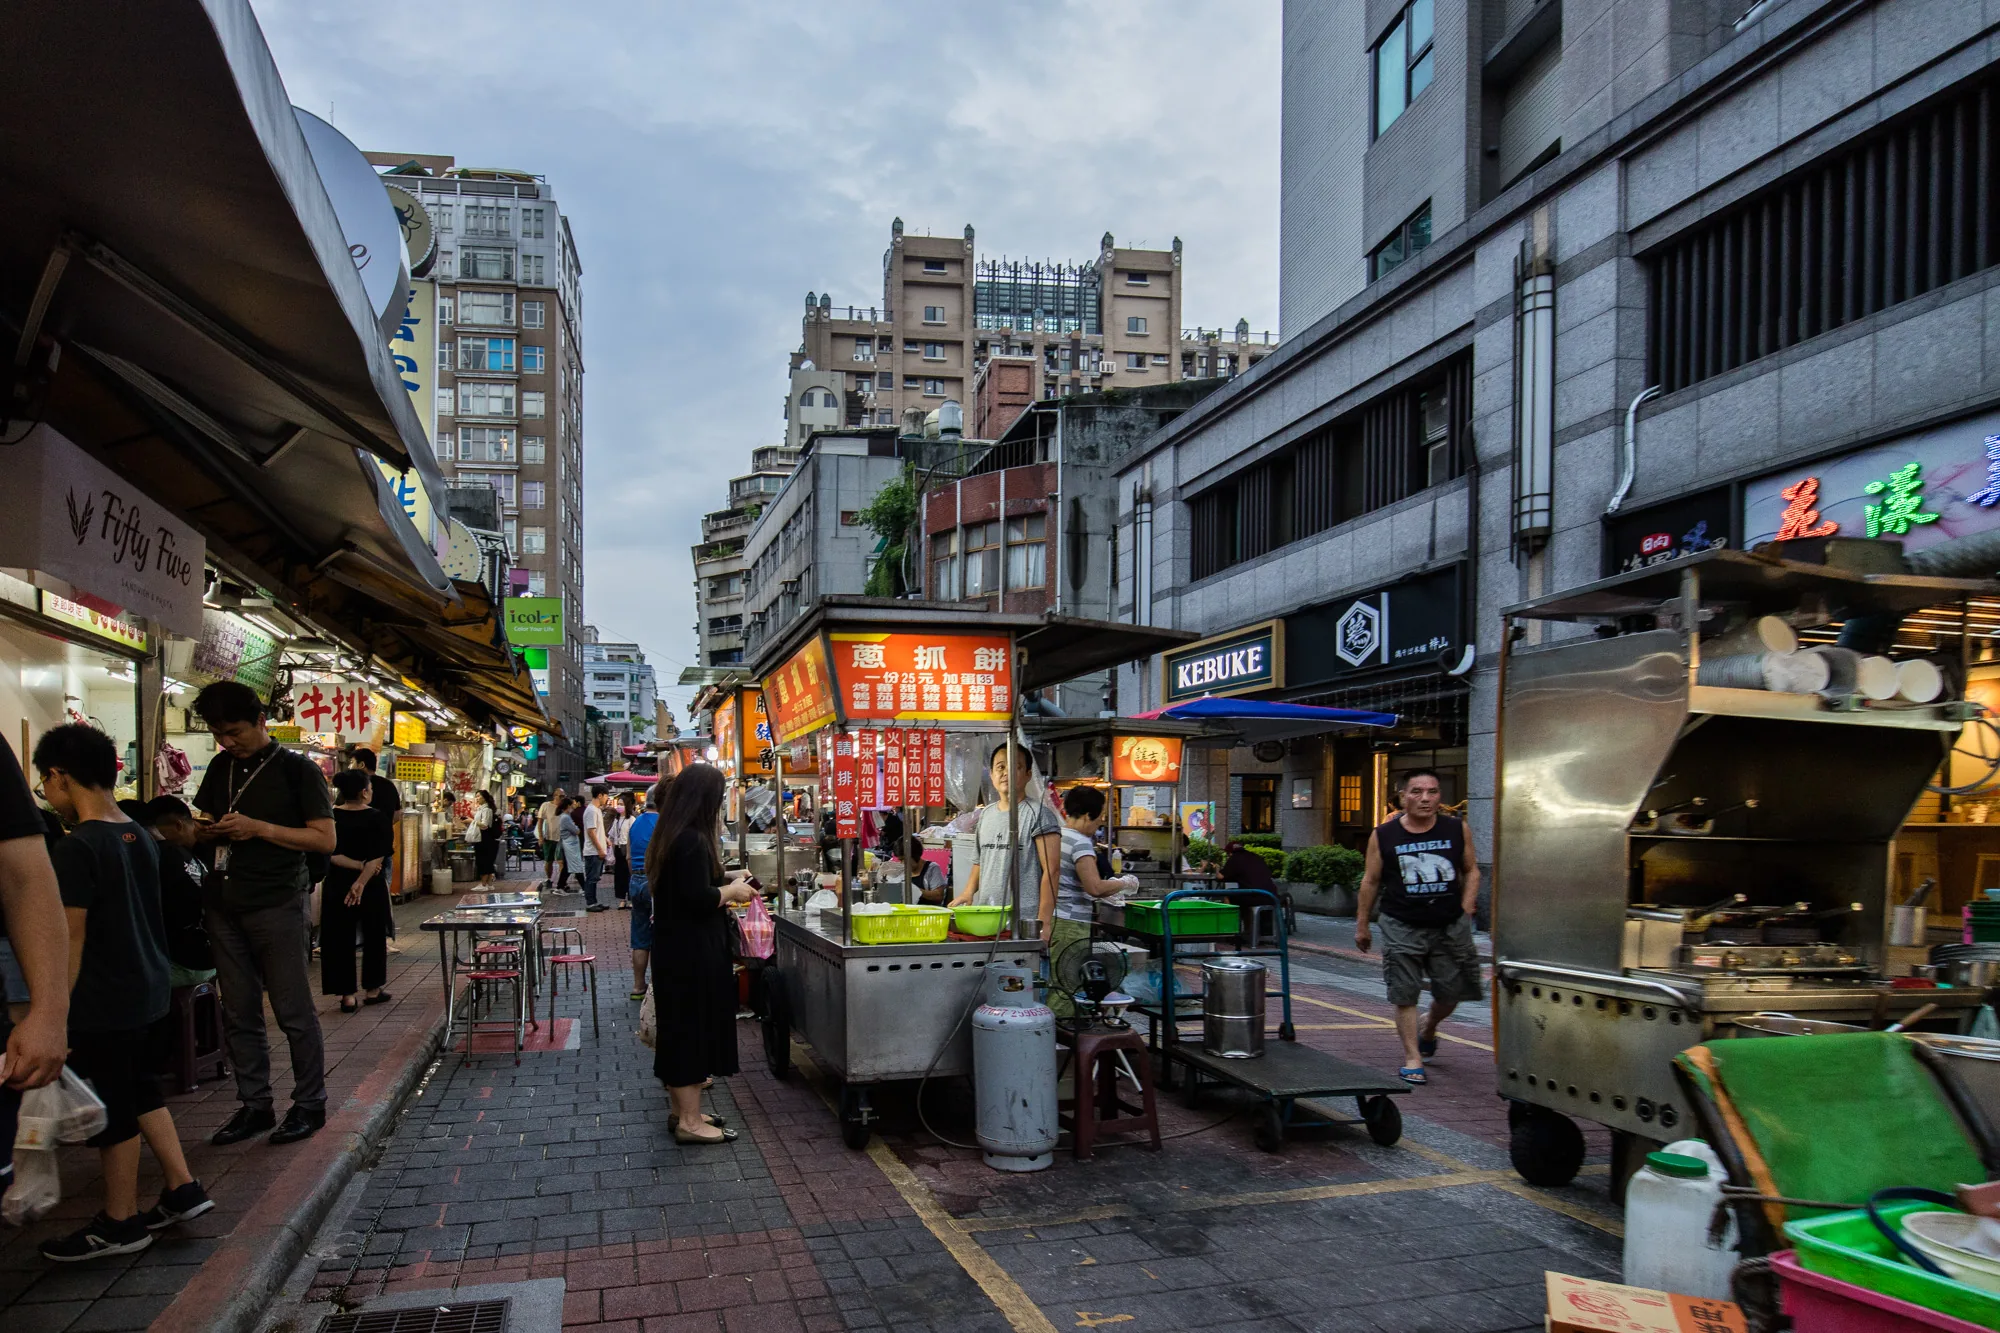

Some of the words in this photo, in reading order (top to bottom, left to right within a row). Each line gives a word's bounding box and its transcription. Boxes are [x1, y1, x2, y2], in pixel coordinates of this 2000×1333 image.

[100, 489, 151, 573] Fifty
[156, 526, 192, 586] Five
[864, 671, 934, 684] 一份25元
[1177, 645, 1263, 689] KEBUKE
[297, 685, 371, 735] 牛排
[836, 740, 854, 817] 請排隊
[861, 733, 874, 804] 玉米加10元
[886, 731, 900, 803] 火腿加10元
[908, 732, 922, 803] 起士加10元
[929, 732, 942, 803] 培根加10元
[1405, 882, 1449, 894] WAVE
